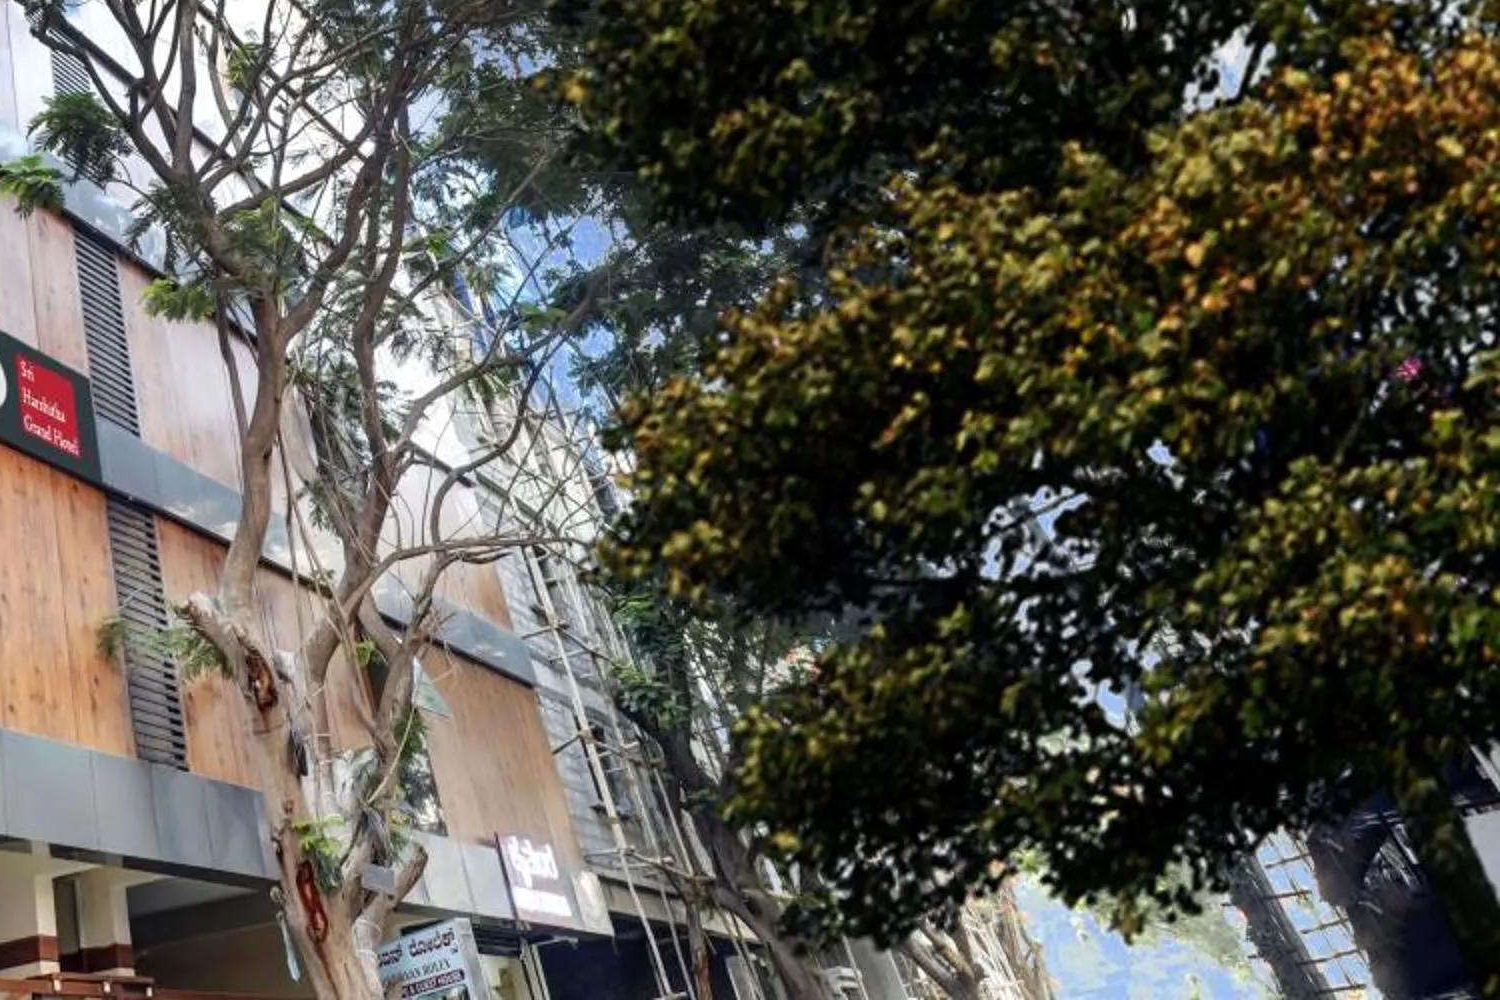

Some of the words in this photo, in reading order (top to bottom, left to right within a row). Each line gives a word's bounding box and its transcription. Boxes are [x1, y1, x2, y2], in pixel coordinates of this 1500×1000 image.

[19, 359, 35, 382] Sri
[23, 413, 53, 443] Grand
[53, 427, 80, 455] Hotel
